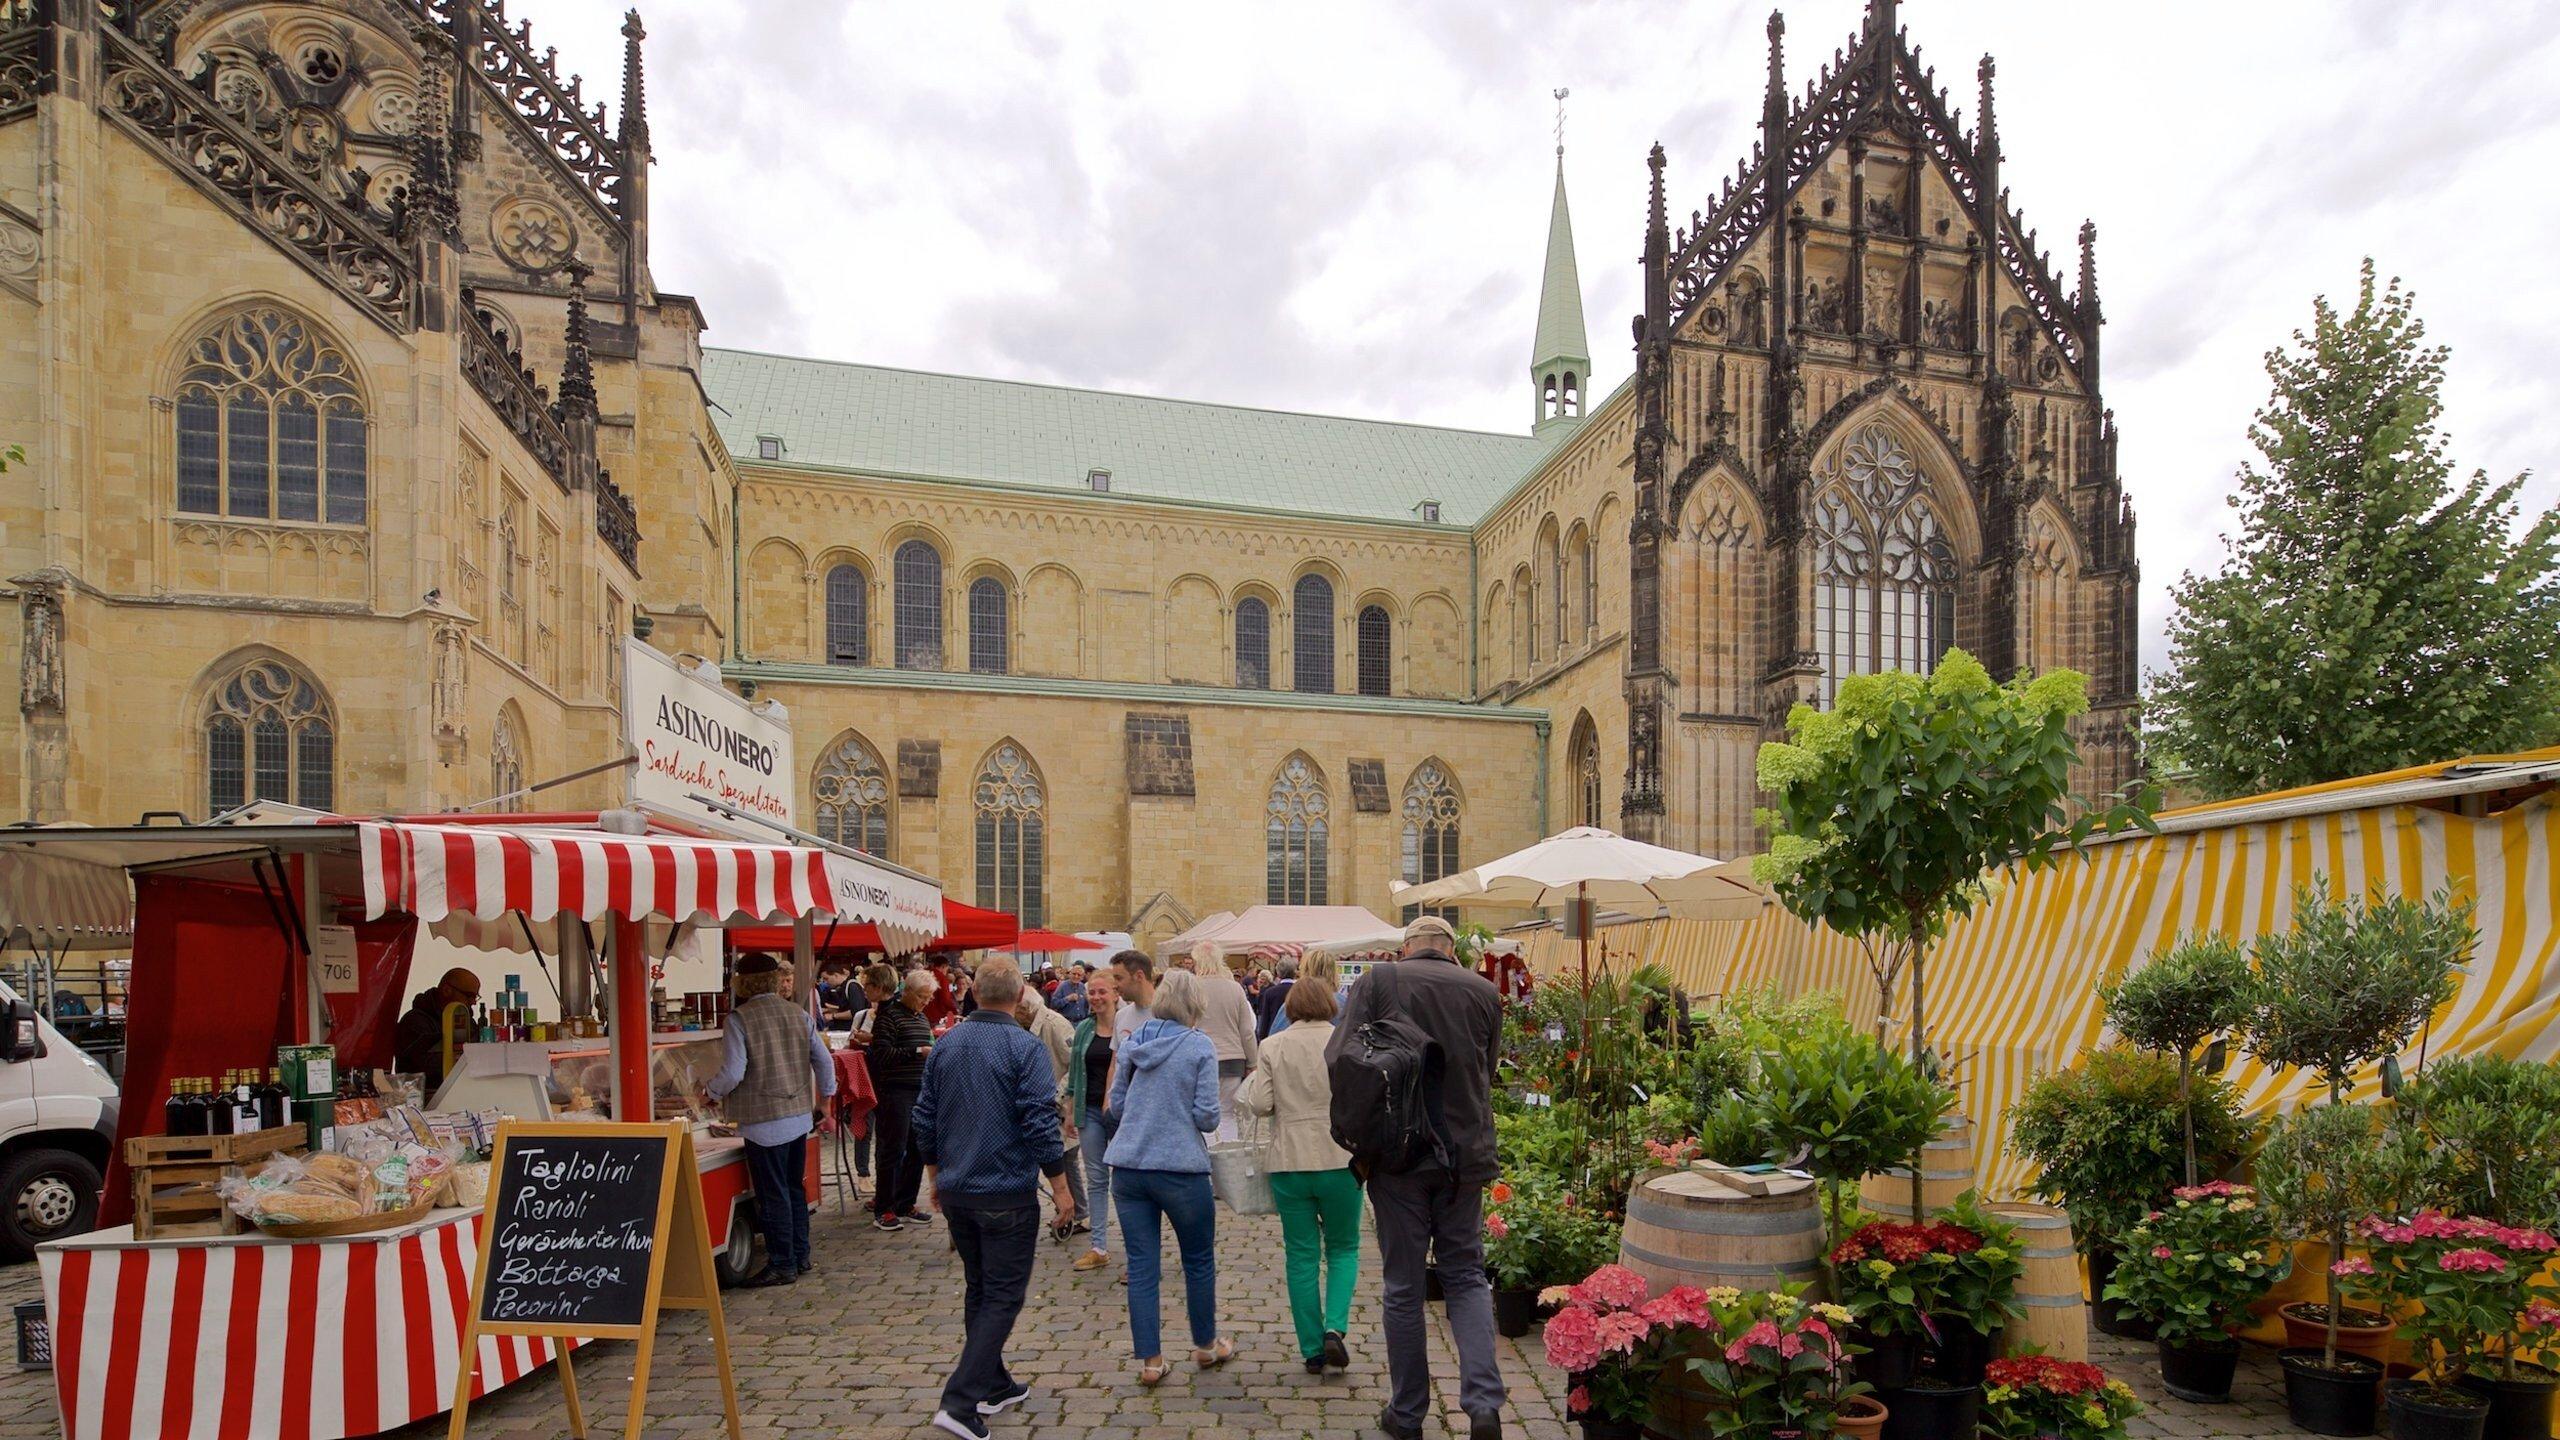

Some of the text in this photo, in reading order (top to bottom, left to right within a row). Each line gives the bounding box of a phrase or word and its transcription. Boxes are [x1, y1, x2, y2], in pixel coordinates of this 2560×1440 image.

[645, 739, 715, 789] Sardische
[323, 963, 352, 980] 706
[517, 1149, 641, 1191] Tagliolini
[513, 1185, 596, 1221] Ravioli
[499, 1218, 653, 1259] Geräucherter Thun
[496, 1256, 628, 1289] Bottarga
[491, 1286, 595, 1318] Pecorini
